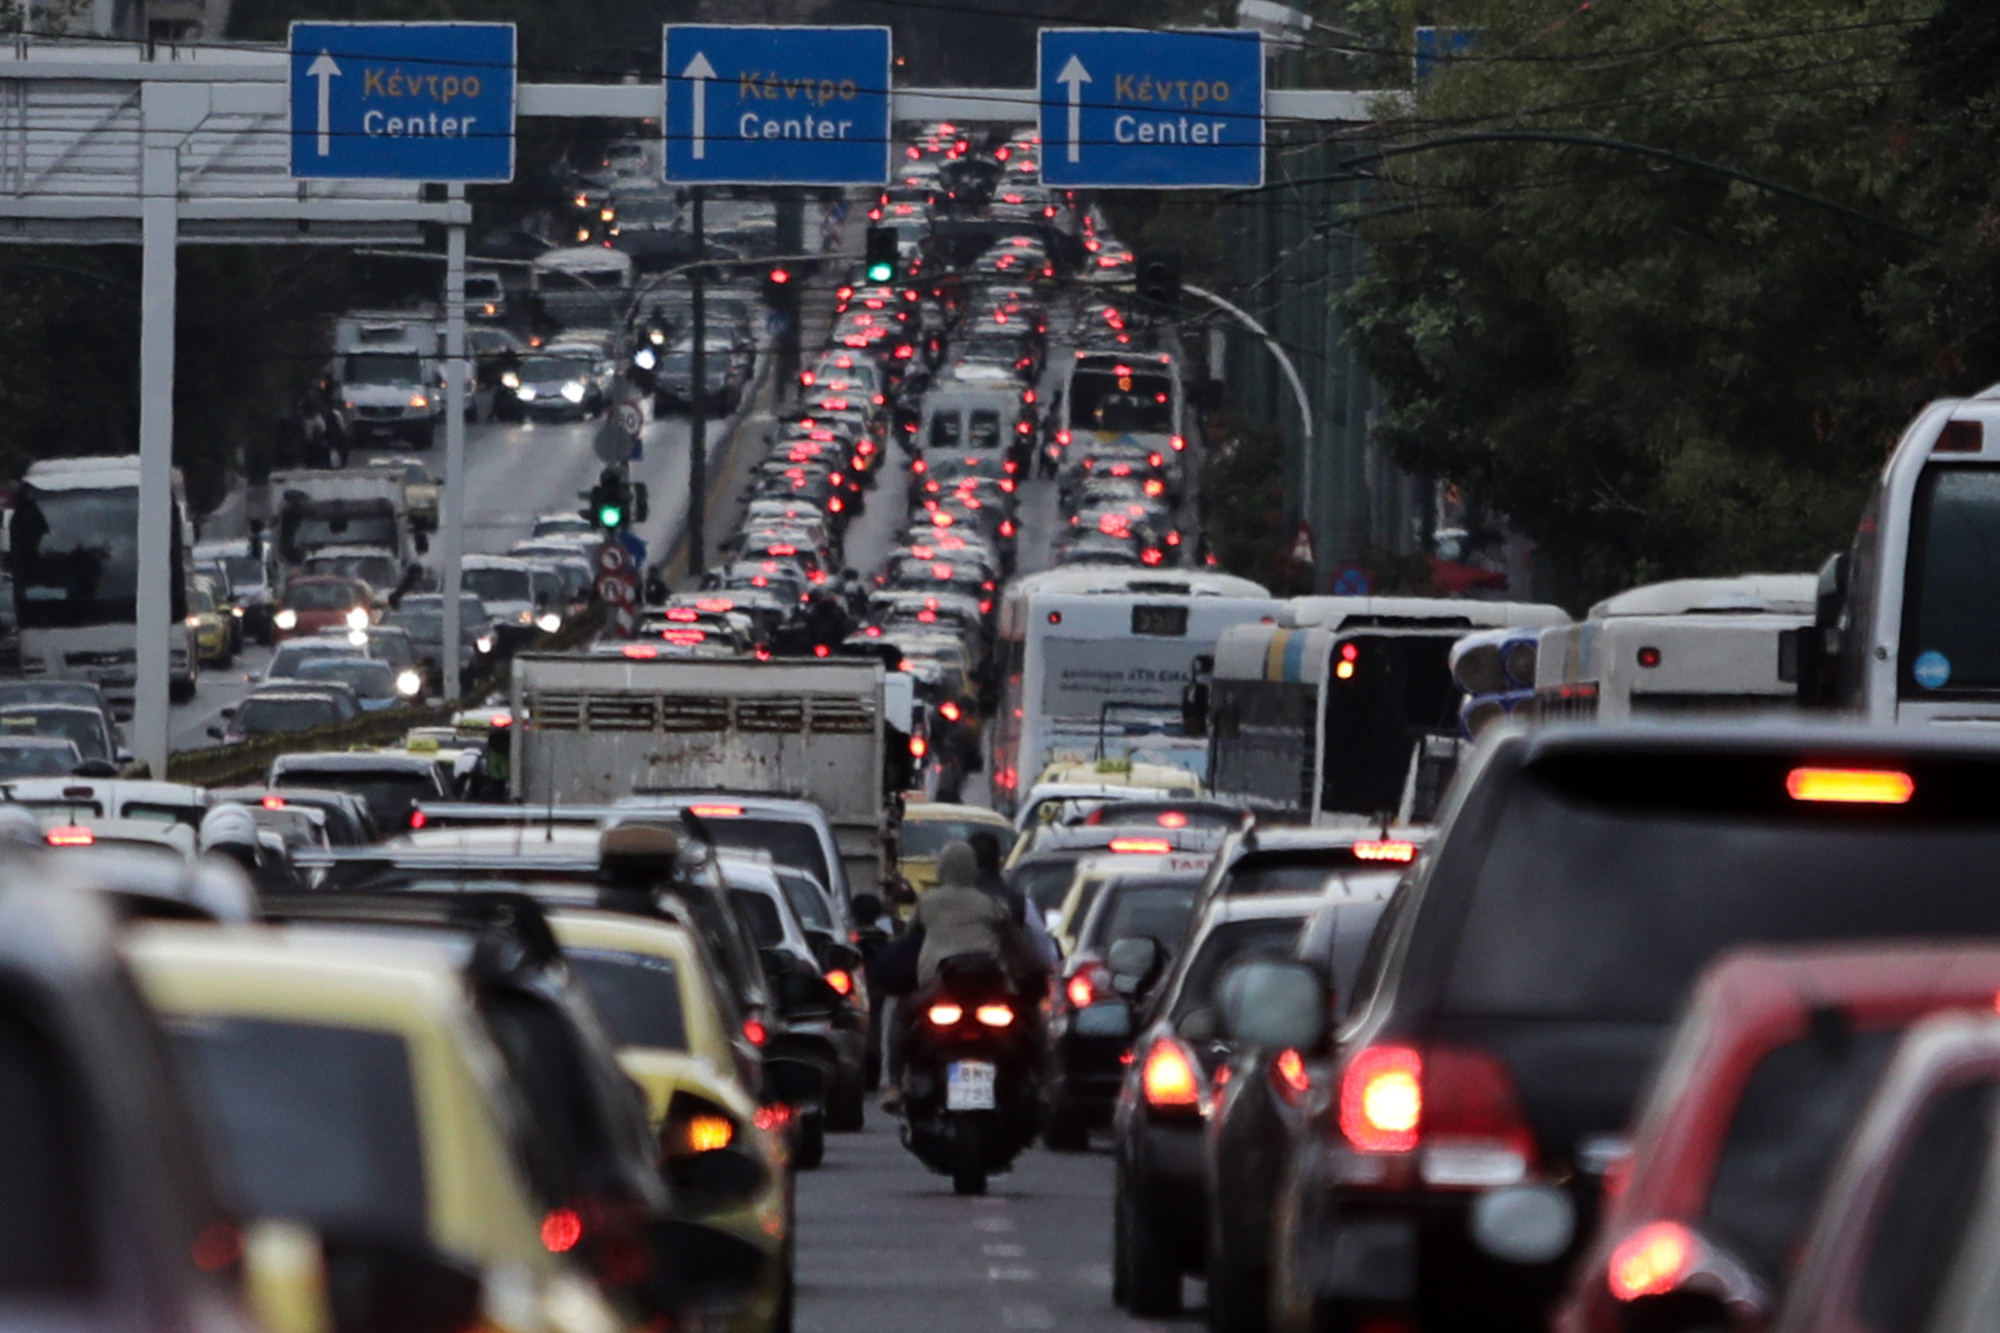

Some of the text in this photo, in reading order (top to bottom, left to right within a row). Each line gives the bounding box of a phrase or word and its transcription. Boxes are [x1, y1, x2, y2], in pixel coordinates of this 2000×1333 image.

[363, 69, 481, 103] Κέντρο
[738, 71, 858, 107] Κέντρο
[1114, 74, 1232, 108] Κέντρο
[363, 109, 477, 138] Center
[739, 112, 852, 140] Center
[1114, 115, 1227, 144] Center
